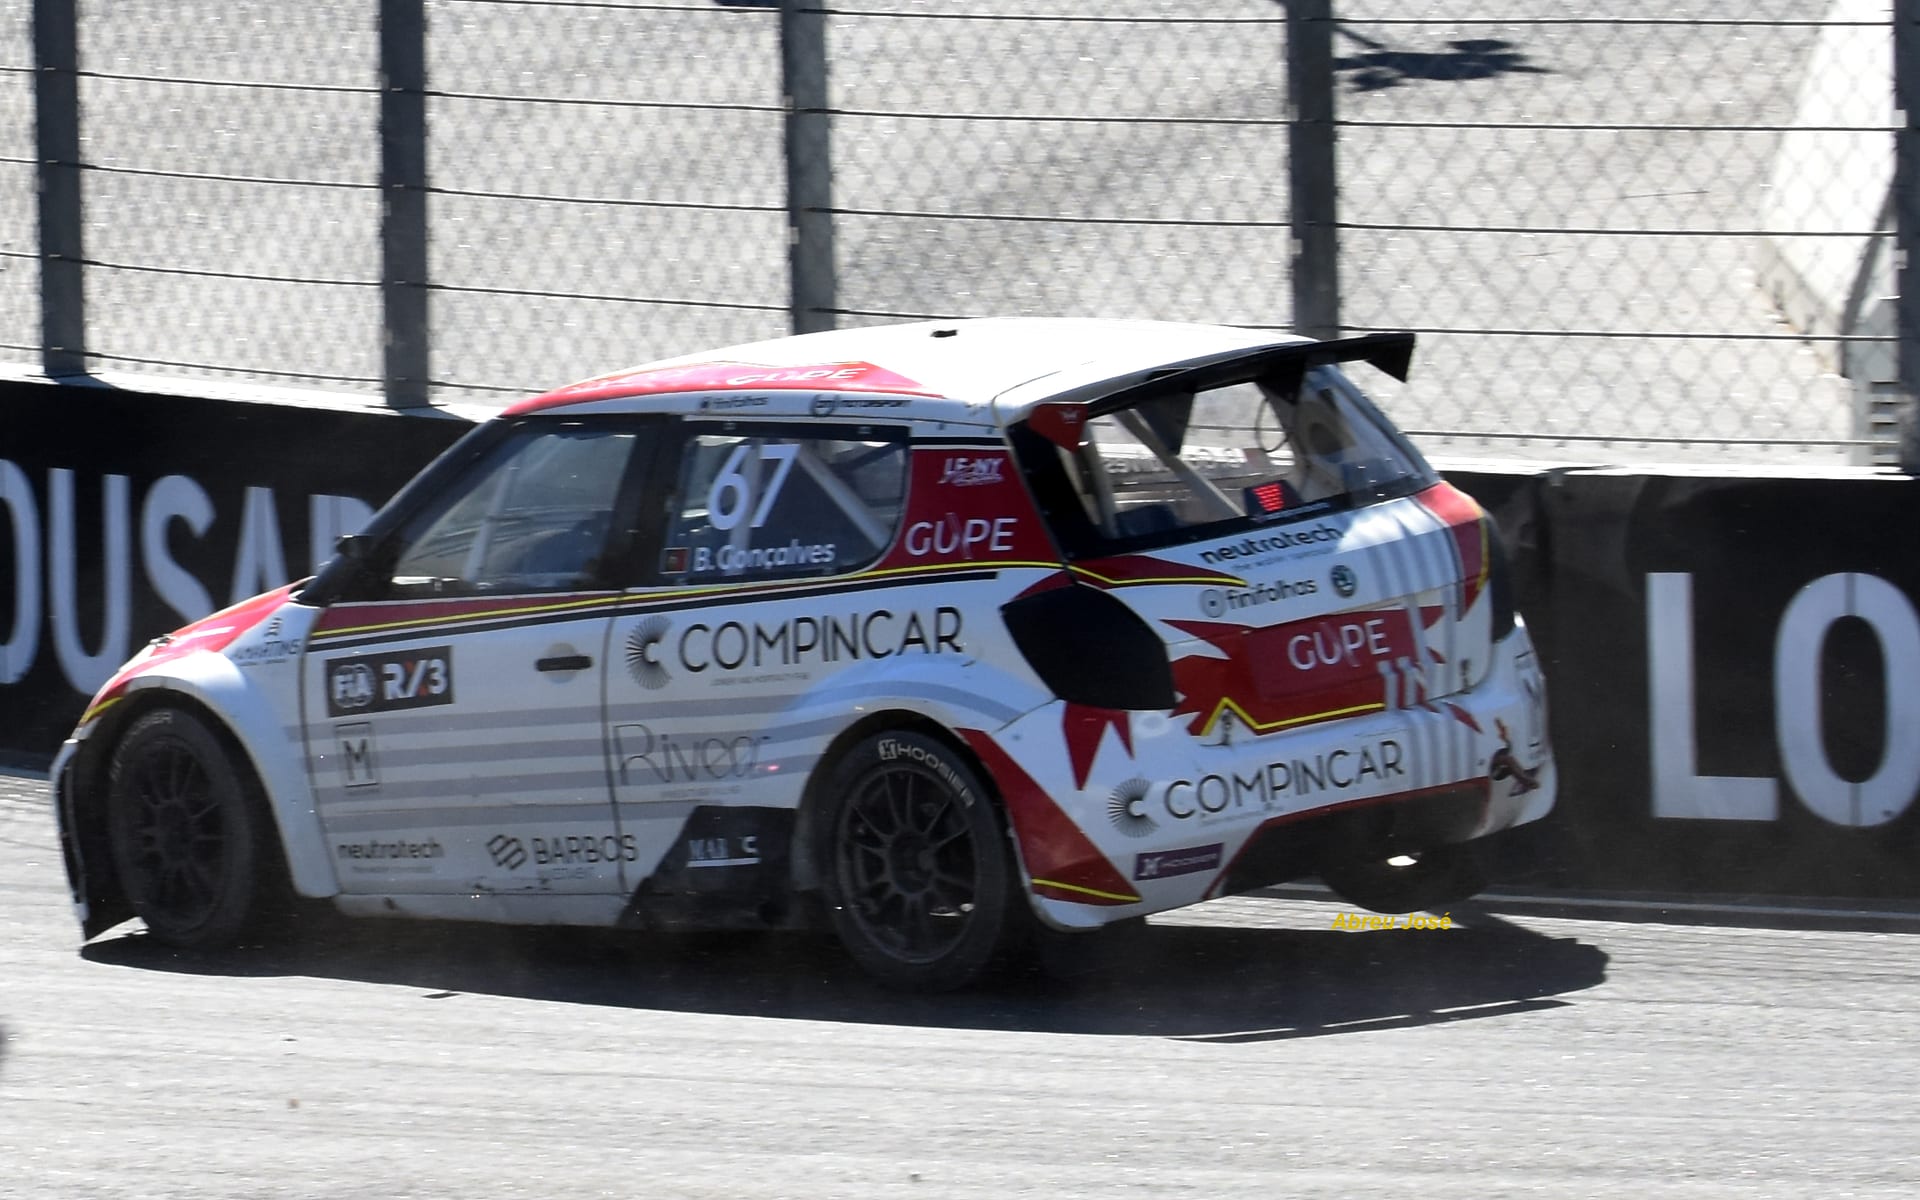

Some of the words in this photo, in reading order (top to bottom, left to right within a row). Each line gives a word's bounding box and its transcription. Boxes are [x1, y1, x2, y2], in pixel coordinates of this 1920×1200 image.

[706, 444, 800, 530] 67
[693, 547, 715, 572] B.
[716, 538, 836, 570] Gonçalves
[904, 513, 1018, 558] GUPE
[678, 606, 963, 673] COMPINCAR
[1287, 619, 1391, 670] GUPE
[1646, 572, 1920, 826] LO
[1164, 739, 1405, 819] COMPINCAR
[531, 833, 640, 865] BARBOS
